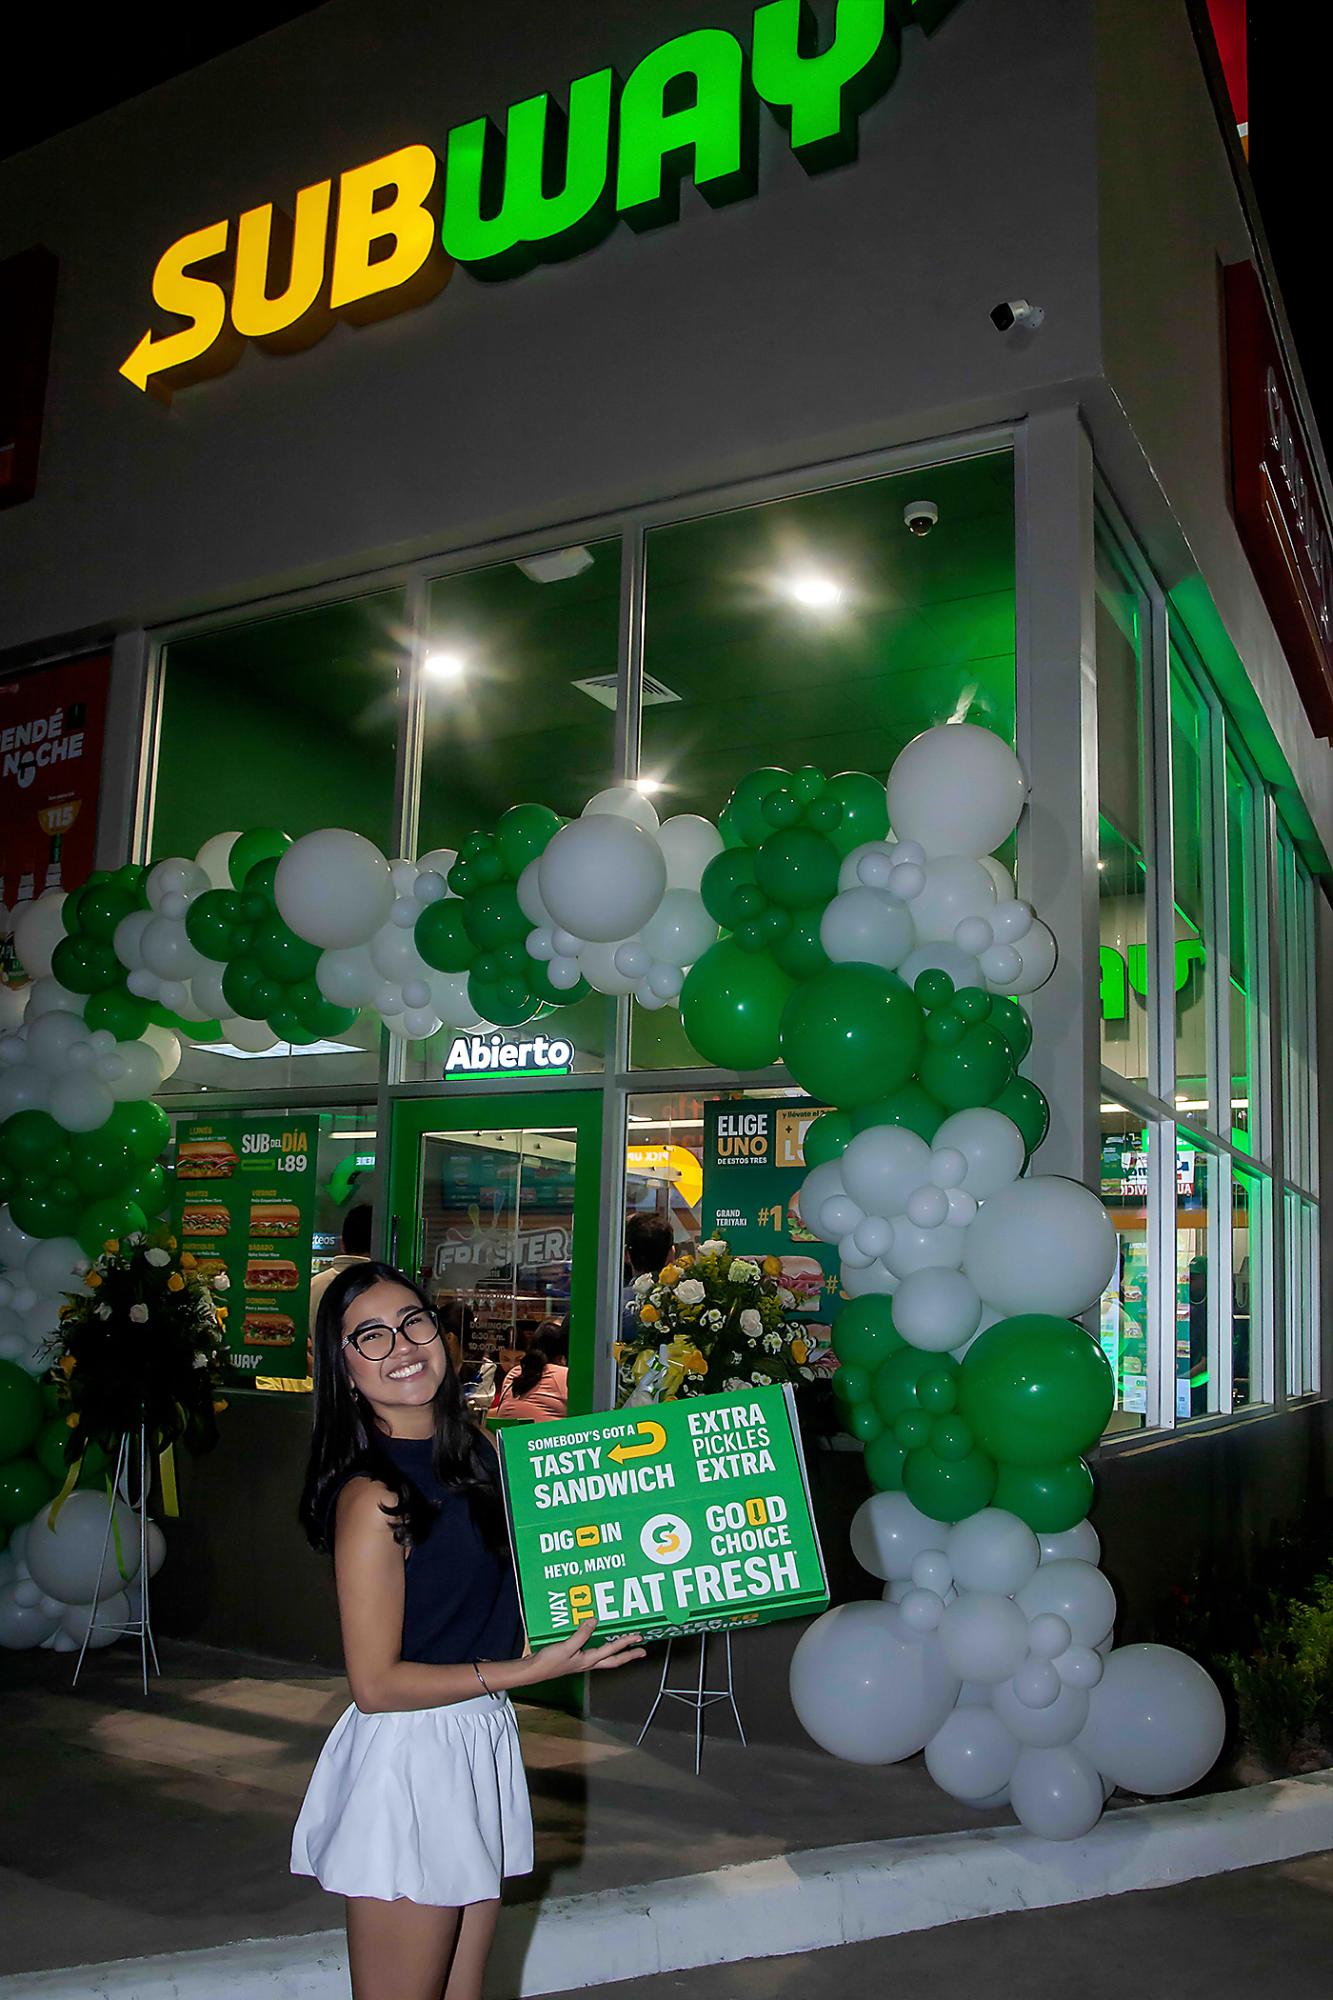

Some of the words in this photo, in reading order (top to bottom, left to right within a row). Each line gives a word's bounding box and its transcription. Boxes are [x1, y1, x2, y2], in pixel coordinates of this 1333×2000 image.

[119, 0, 886, 391] SUBWAY
[0, 707, 63, 753] ENDÉ
[445, 1035, 570, 1070] Abierto
[718, 1114, 768, 1136] ELIGE
[241, 1134, 270, 1153] SUB
[271, 1139, 281, 1148] DEL
[282, 1129, 307, 1152] DÍA
[718, 1136, 768, 1156] UNO
[278, 1155, 307, 1172] L89
[716, 1209, 740, 1217] GRAND
[716, 1218, 747, 1226] TERIYAKI
[758, 1205, 782, 1231] #1
[230, 1354, 259, 1369] WAY
[687, 1403, 766, 1436] EXTRA
[527, 1430, 600, 1451] SOMEBODY'S
[603, 1426, 625, 1439] GOT
[627, 1424, 636, 1436] A
[692, 1427, 771, 1458] PICKLES
[530, 1447, 602, 1478] TASTY
[696, 1449, 776, 1483] EXTRA
[534, 1463, 675, 1509] SANDWICH
[539, 1529, 575, 1553] DIG
[600, 1521, 622, 1543] IN
[711, 1524, 792, 1556] CHOICE
[544, 1561, 583, 1579] HEYO,
[584, 1554, 626, 1573] MAYO!
[594, 1573, 665, 1621] EAT
[672, 1551, 800, 1608] FRESH
[548, 1591, 570, 1628] WAY
[647, 1619, 723, 1635] CATER
